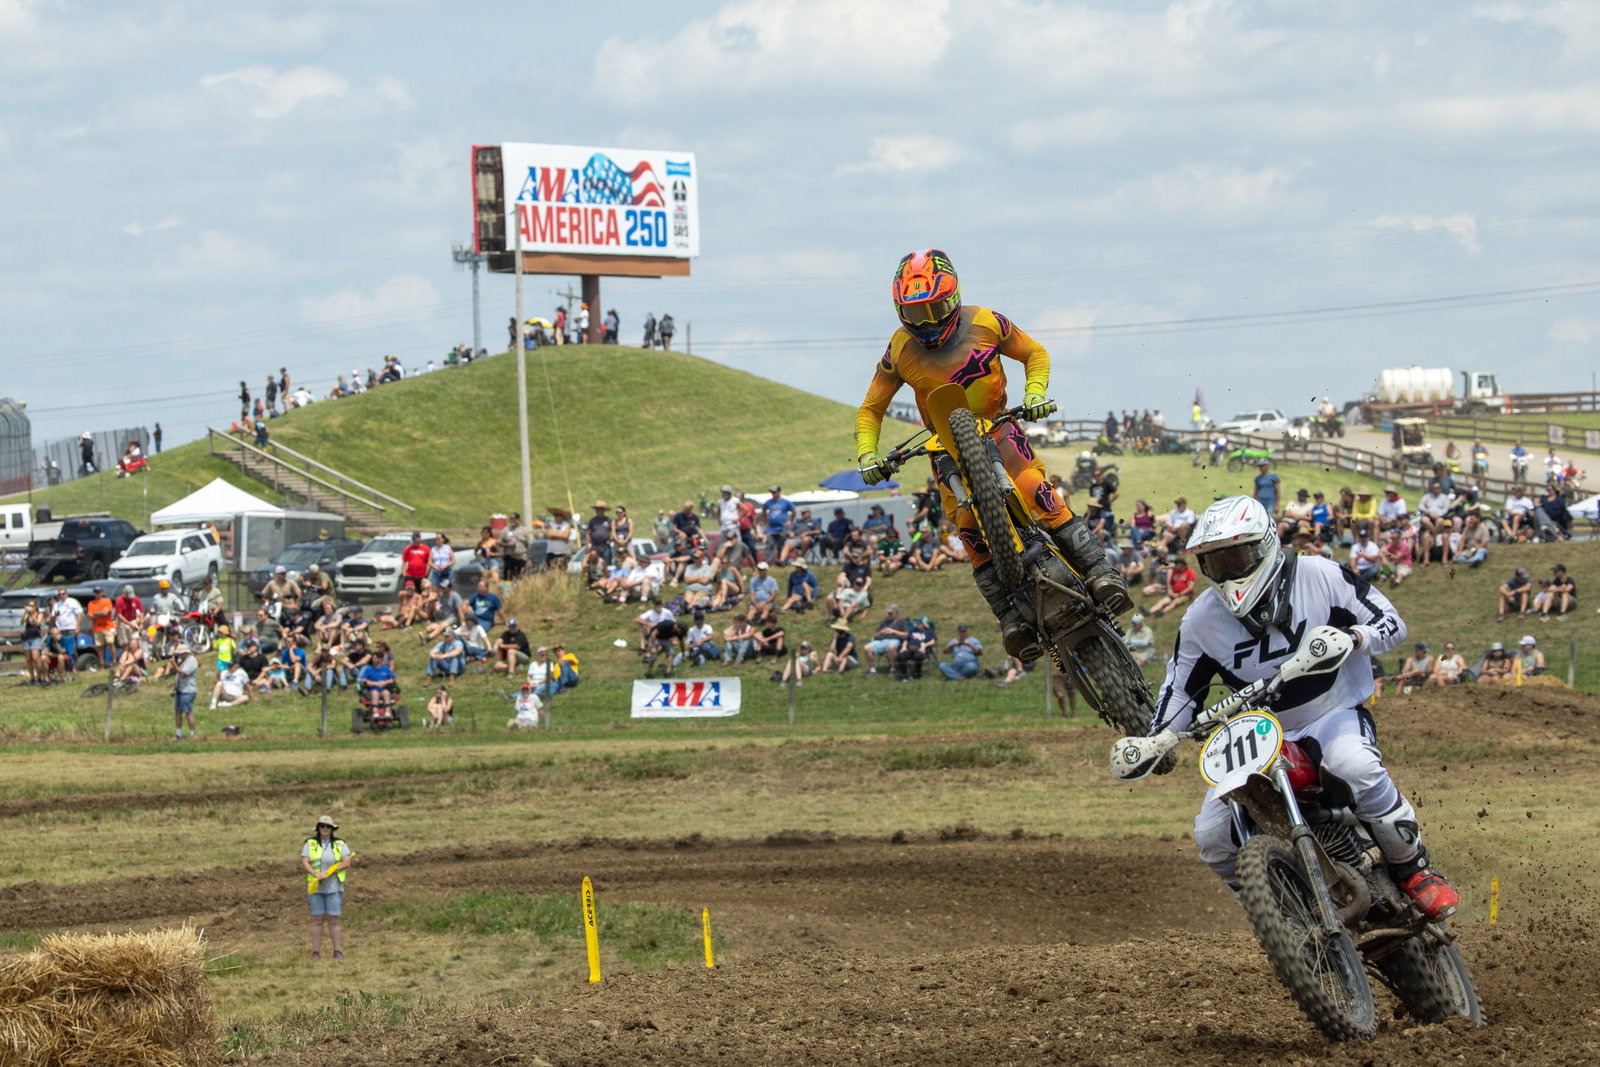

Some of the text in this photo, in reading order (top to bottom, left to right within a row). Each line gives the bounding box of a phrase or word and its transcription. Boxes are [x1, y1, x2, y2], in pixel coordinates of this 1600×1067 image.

[516, 166, 580, 202] AMA
[517, 203, 667, 247] AMERICA 250
[1234, 618, 1307, 669] FLY
[644, 682, 721, 707] AMA
[1259, 721, 1267, 733] 7
[1222, 728, 1258, 774] 111
[585, 889, 594, 927] ACERBIS
